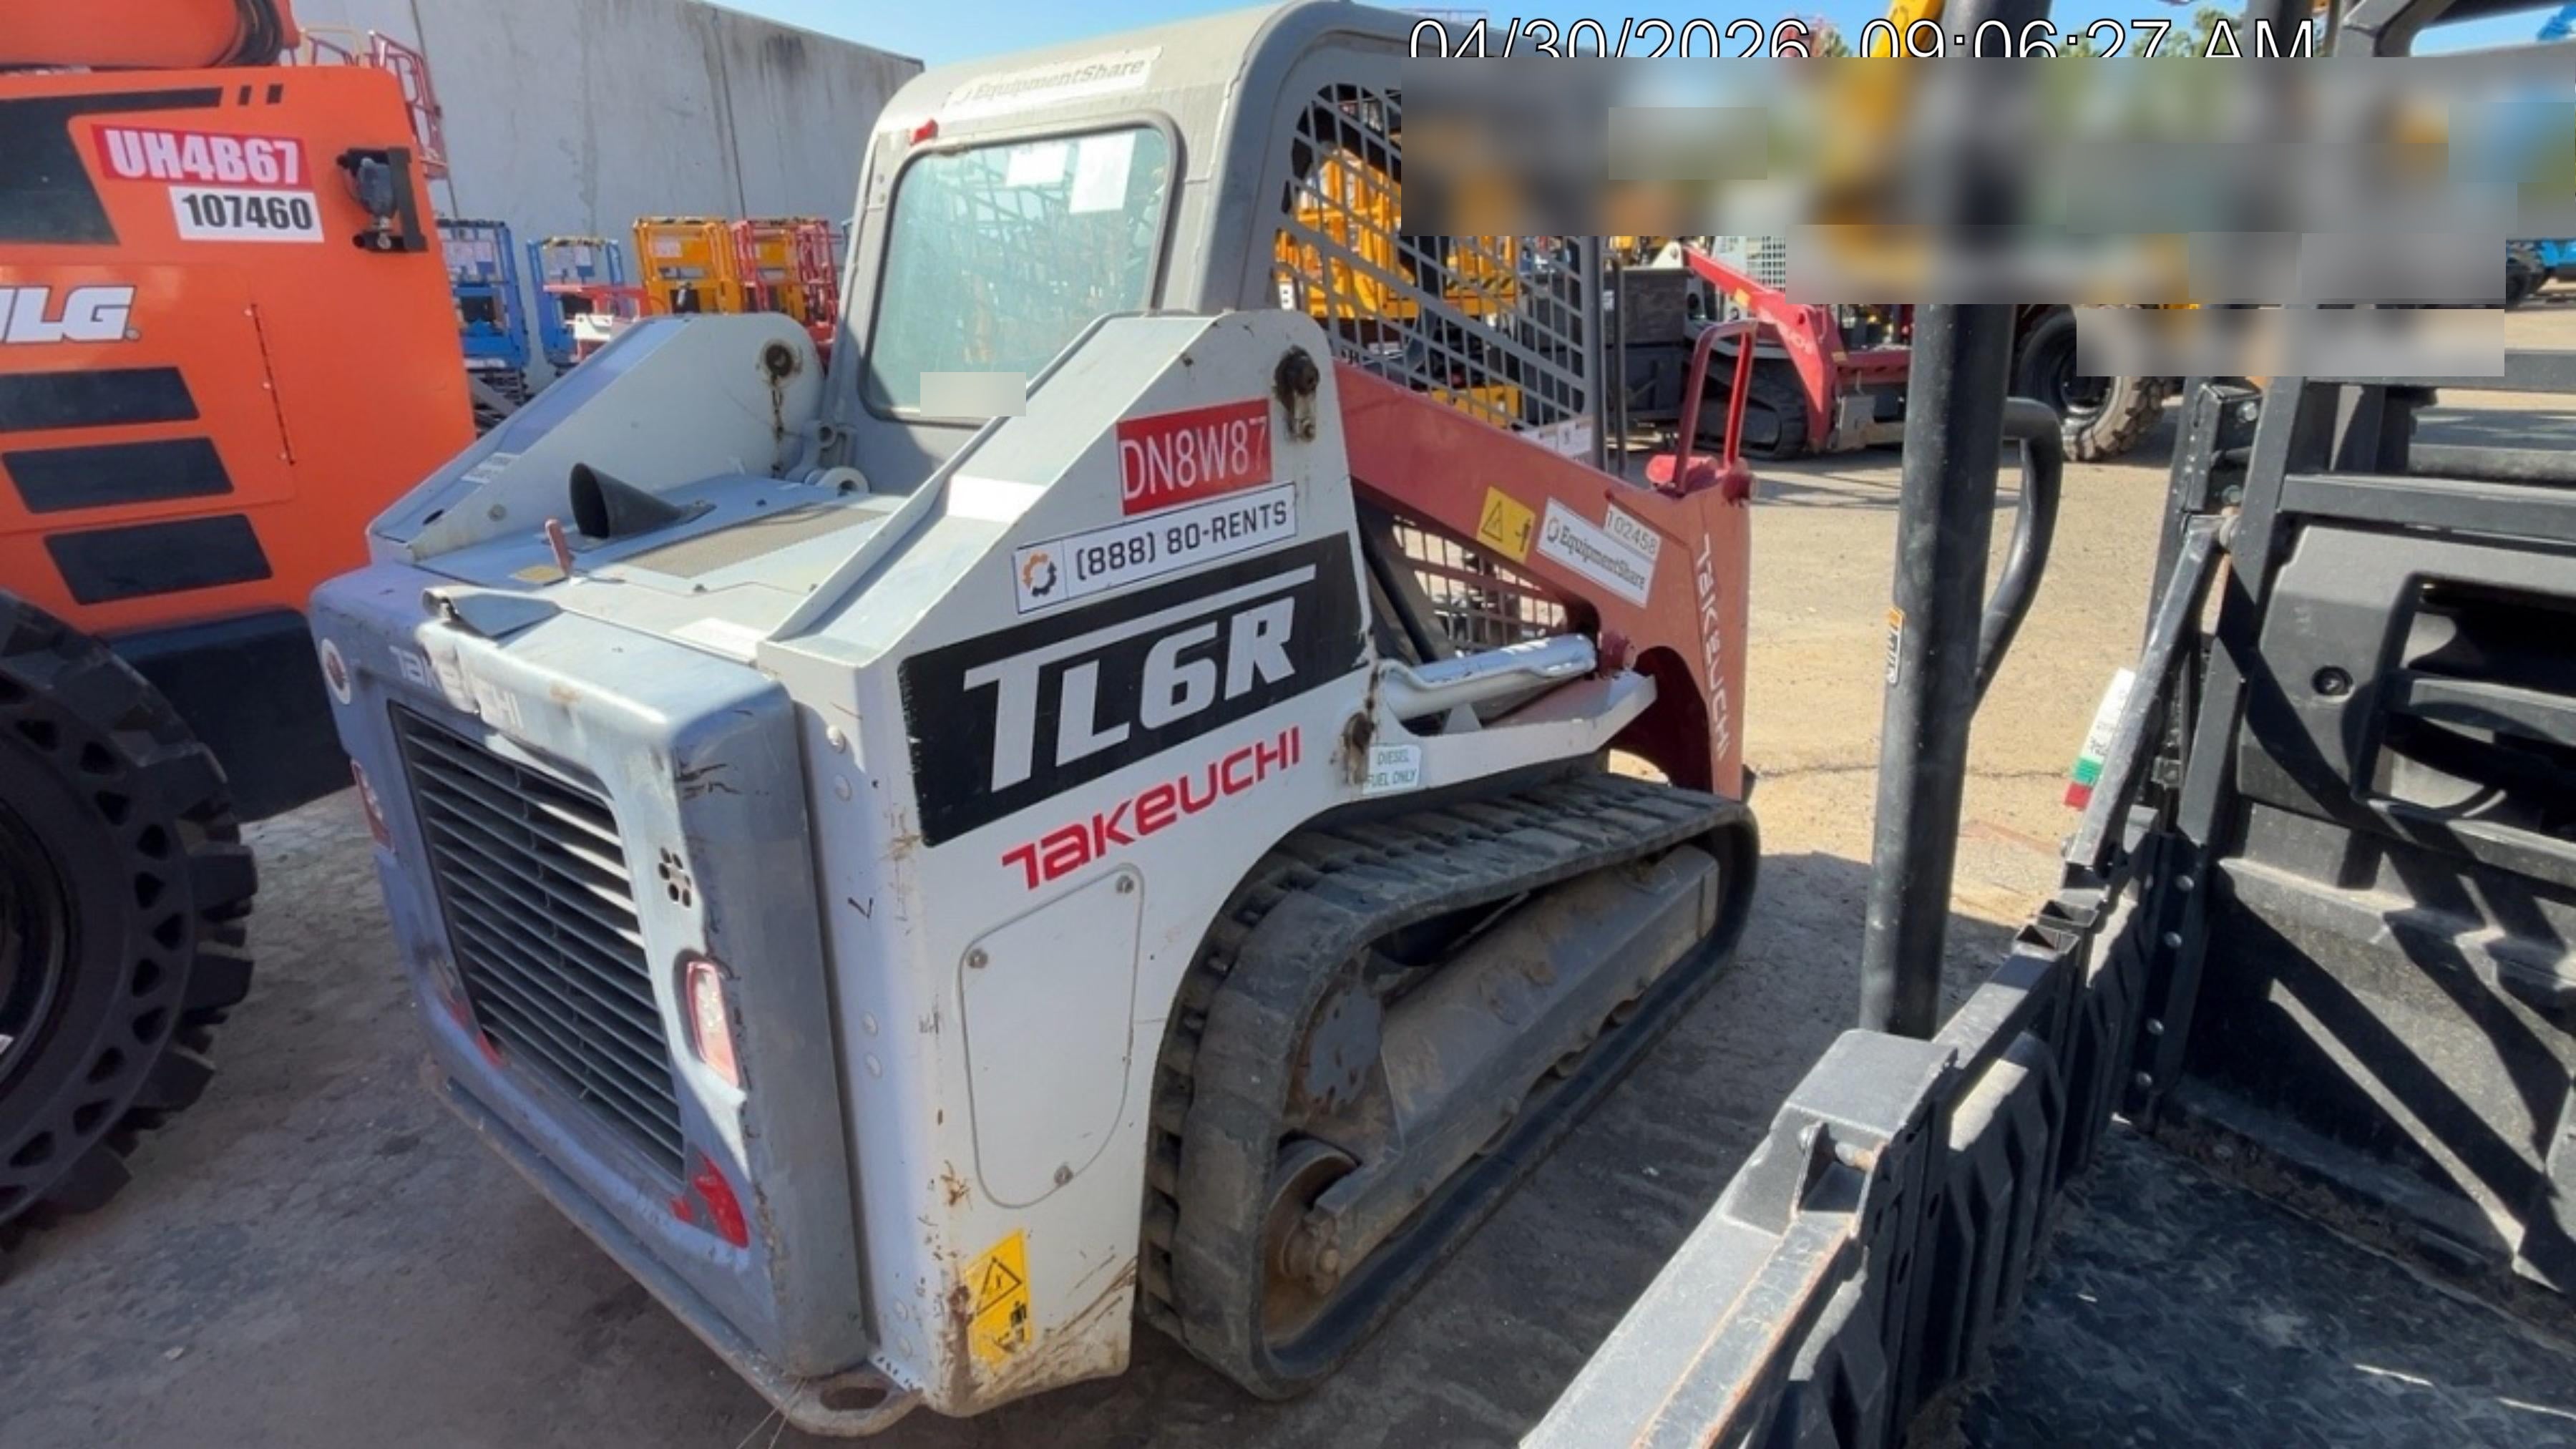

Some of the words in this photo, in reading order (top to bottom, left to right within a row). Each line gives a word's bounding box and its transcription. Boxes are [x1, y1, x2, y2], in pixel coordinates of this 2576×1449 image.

[973, 59, 1146, 100] EquipmentShare
[104, 128, 299, 184] UH4B67
[182, 193, 313, 230] 107460
[1118, 415, 1268, 501] DN8W87
[1077, 532, 1156, 581] (888)
[1167, 500, 1288, 556] 80-RENTS
[1559, 525, 1645, 591] EquipmentShare
[1608, 510, 1658, 555] 102458
[963, 563, 1317, 793] TL6R
